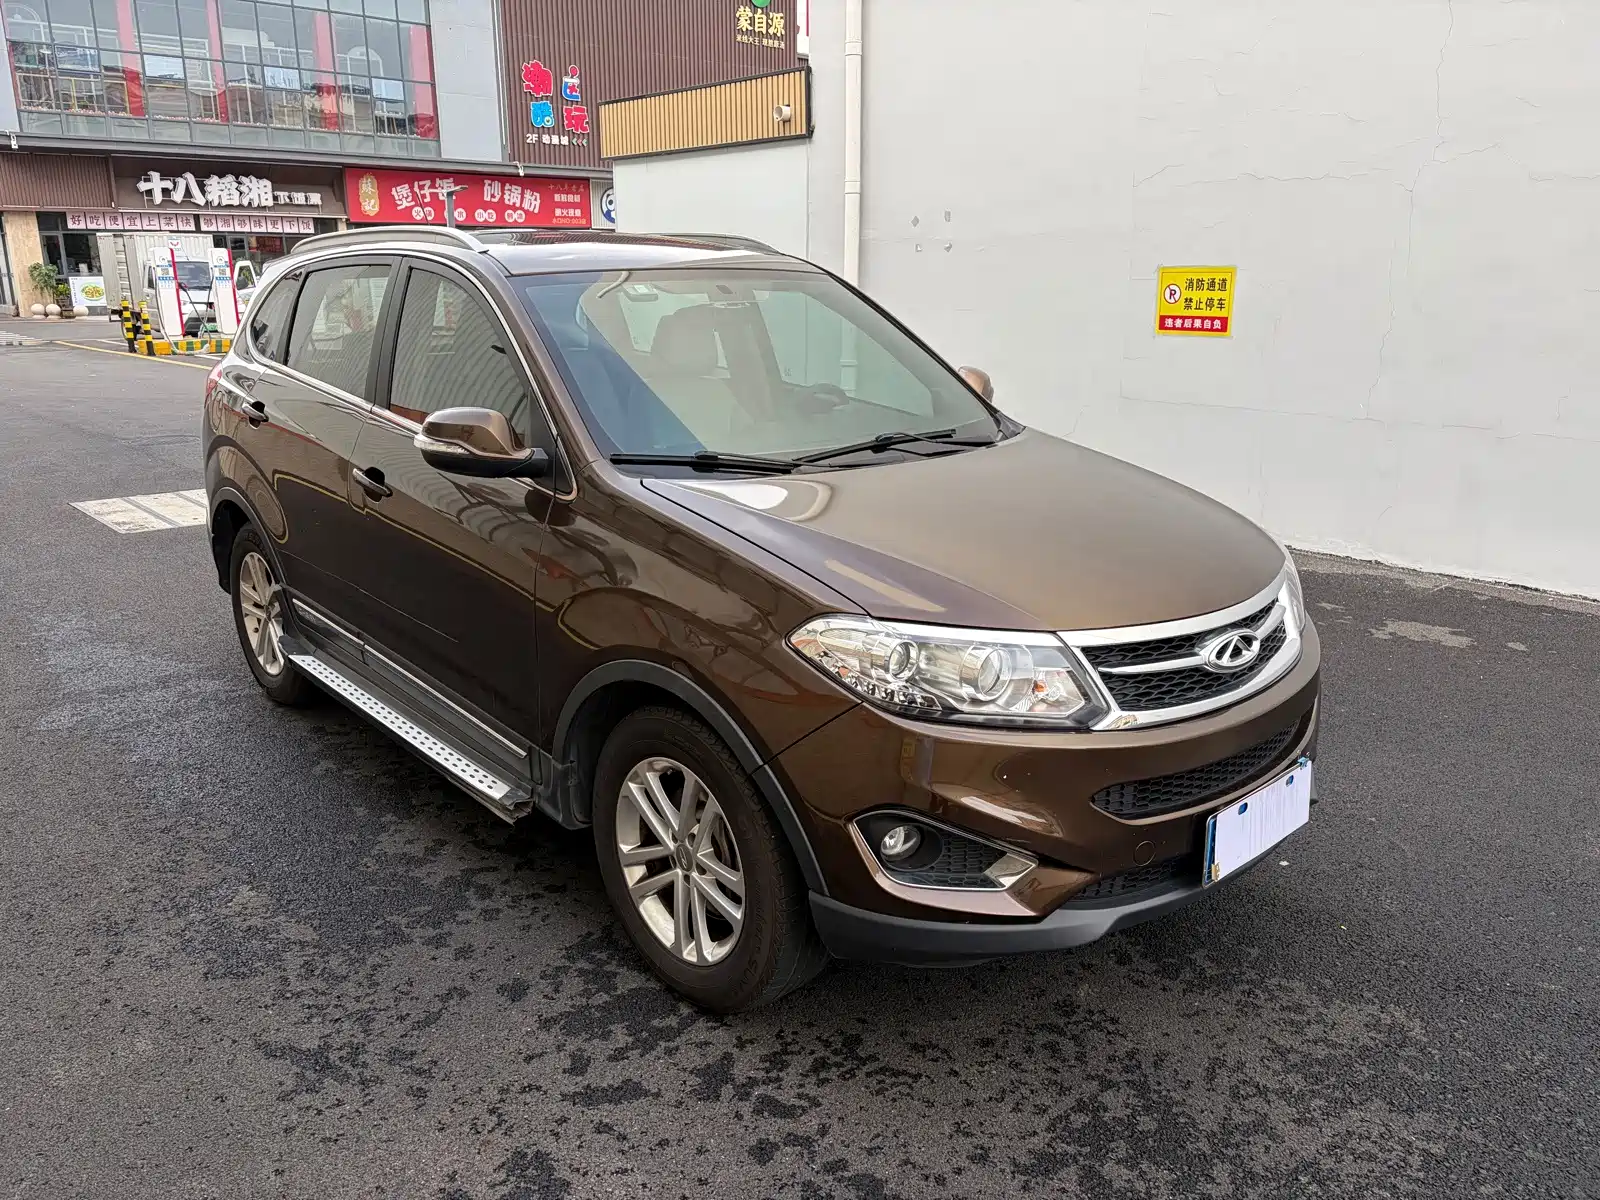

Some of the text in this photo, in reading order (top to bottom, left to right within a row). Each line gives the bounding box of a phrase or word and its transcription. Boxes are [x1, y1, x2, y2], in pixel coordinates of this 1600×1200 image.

[736, 5, 785, 37] 蒙自源
[526, 134, 539, 144] 2F
[483, 180, 541, 213] 砂锅粉
[70, 214, 312, 231] 好吃便宜上菜快 够湘够味更下饭
[1184, 278, 1228, 291] 消防通道
[1183, 297, 1226, 311] 禁止停车
[1164, 318, 1221, 330] 违者后果自负
